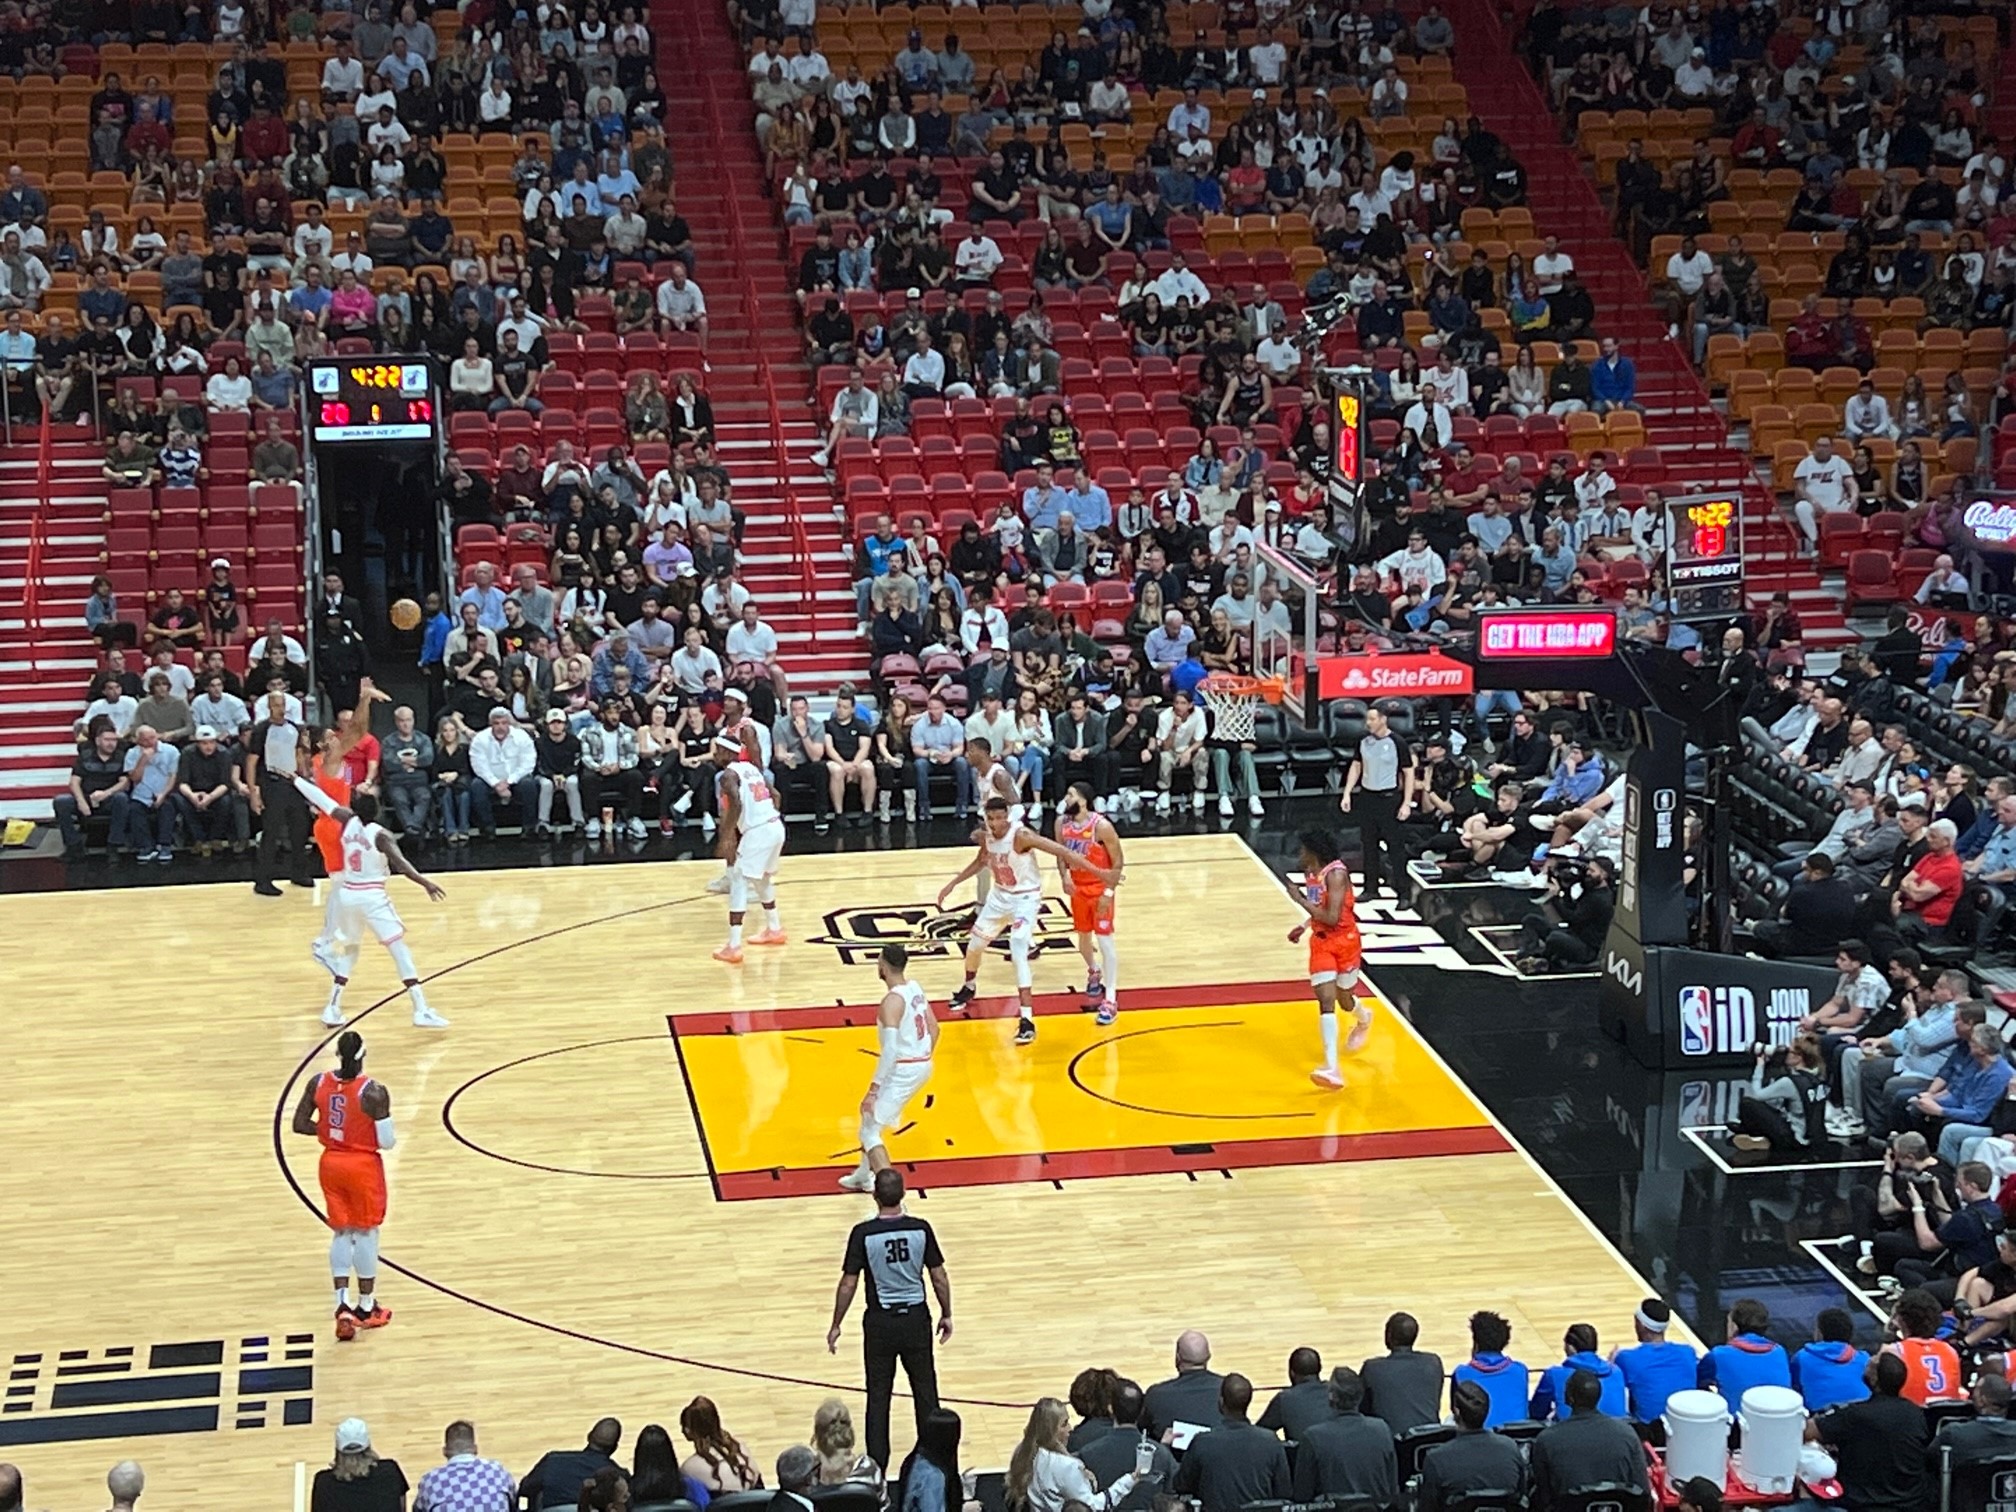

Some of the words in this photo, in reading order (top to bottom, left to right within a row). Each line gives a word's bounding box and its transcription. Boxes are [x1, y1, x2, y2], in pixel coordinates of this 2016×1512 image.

[351, 365, 400, 388] 4:22
[1688, 502, 1733, 527] 4:22
[1695, 527, 1721, 557] 13
[1691, 563, 1740, 577] TISSOT
[1487, 623, 1516, 649] GET
[1517, 623, 1544, 648] THE
[1546, 623, 1576, 647] NBA
[1577, 623, 1608, 647] APP
[1766, 988, 1810, 1019] JOIN
[330, 1094, 346, 1127] 5
[885, 1238, 910, 1264] 36
[1921, 1354, 1947, 1393] 3
